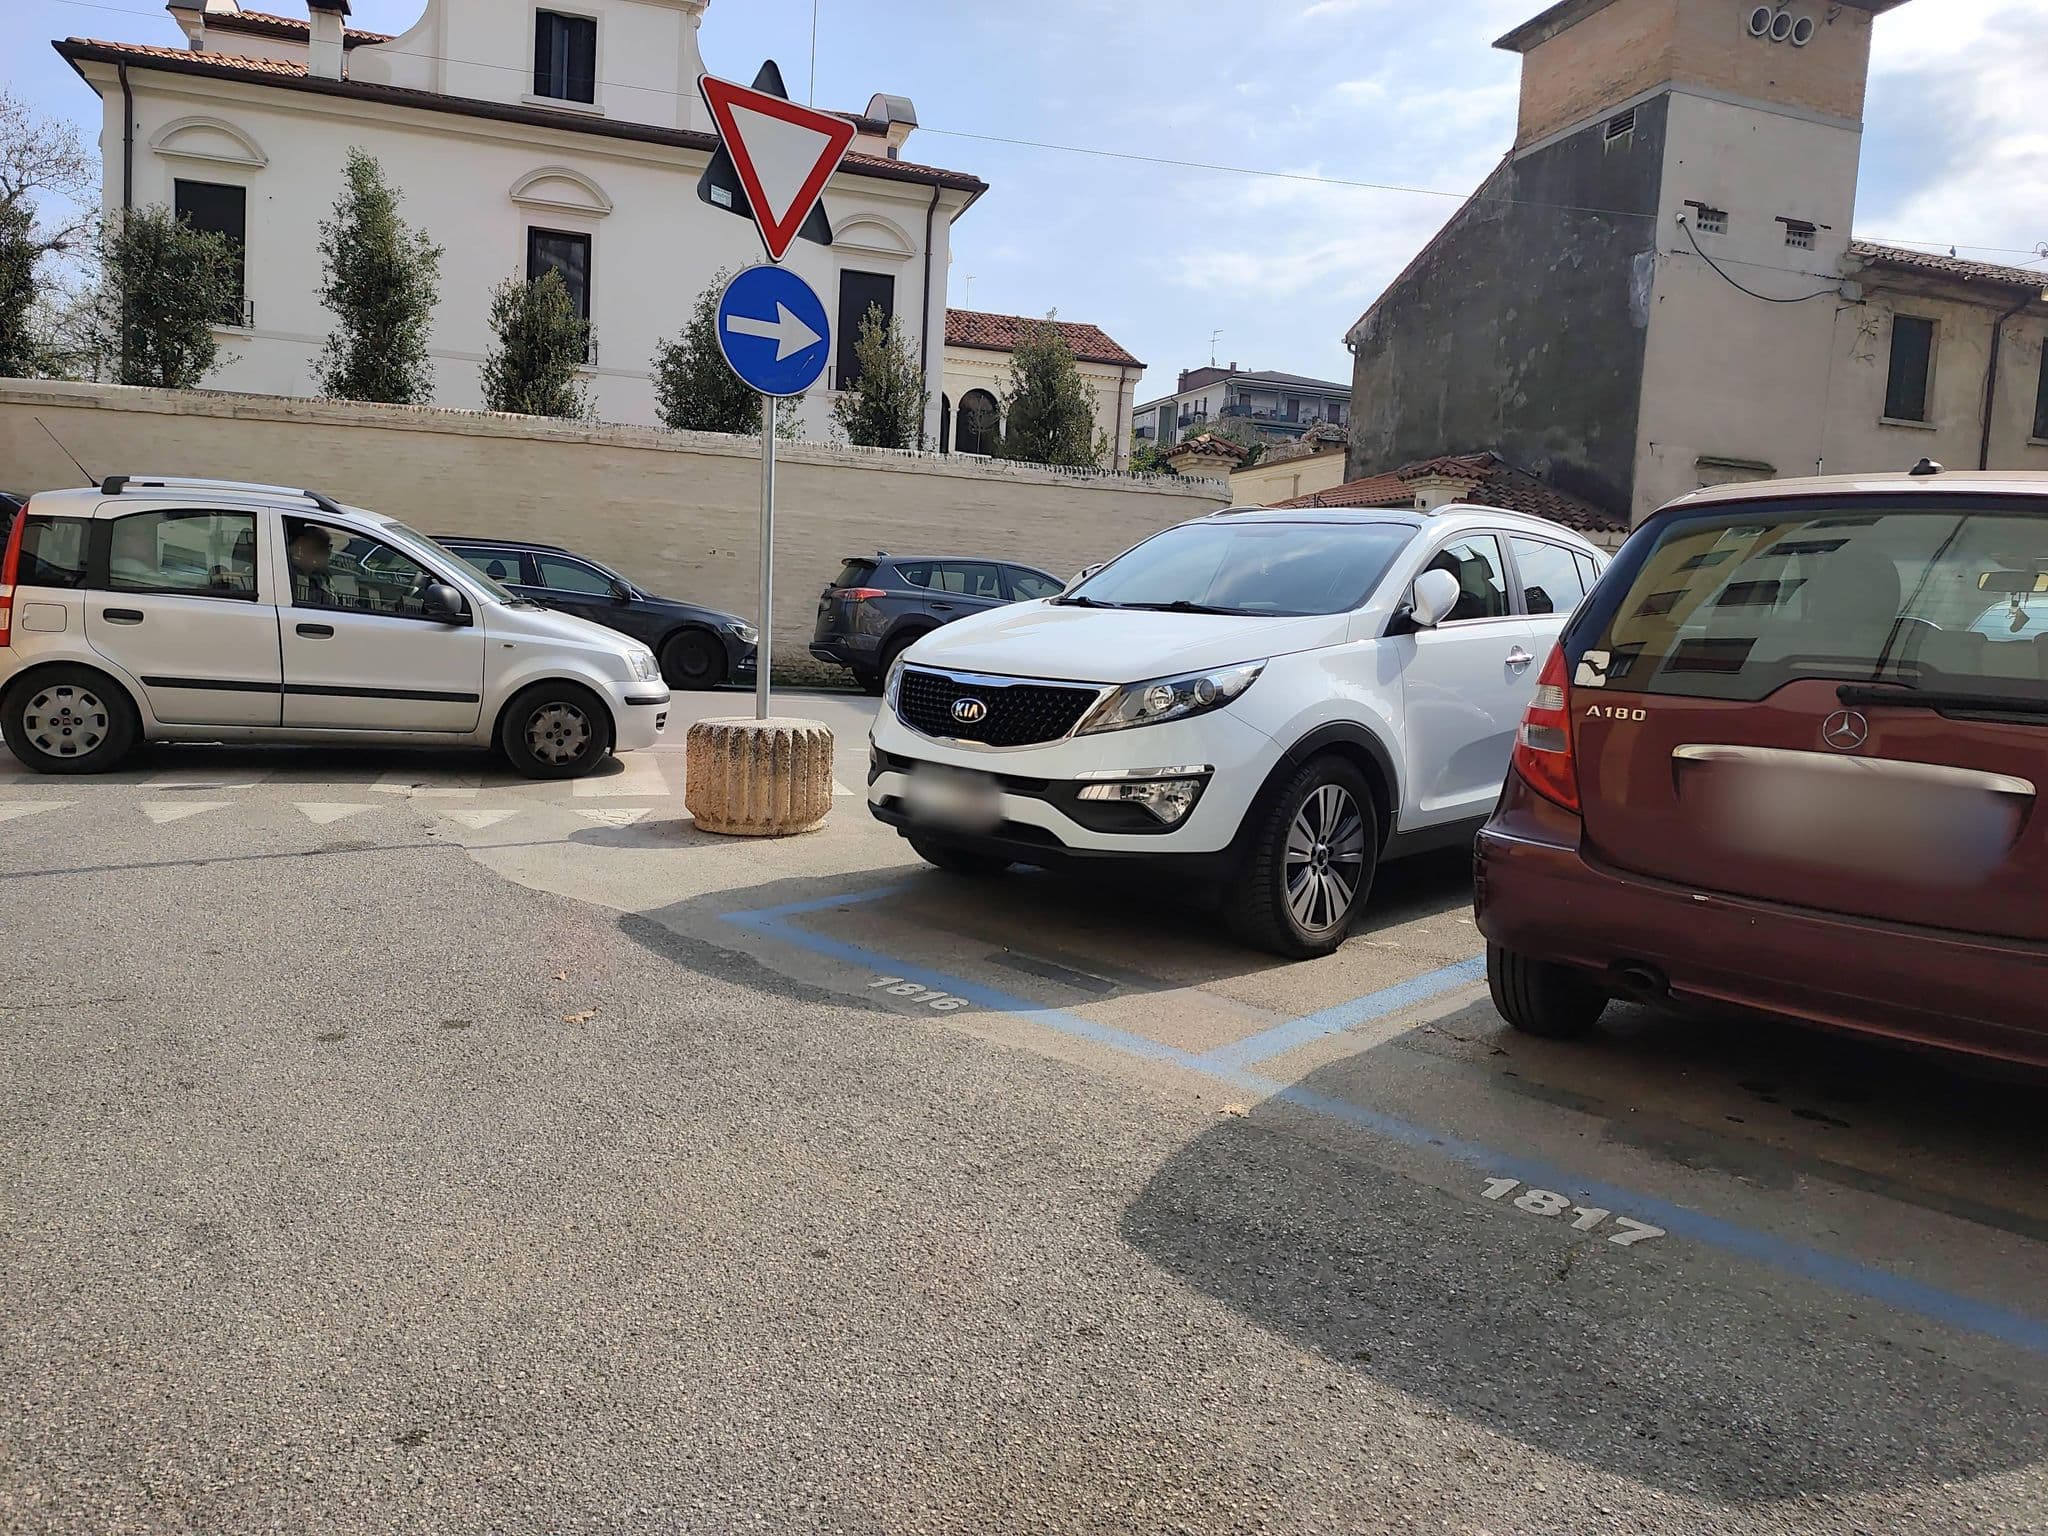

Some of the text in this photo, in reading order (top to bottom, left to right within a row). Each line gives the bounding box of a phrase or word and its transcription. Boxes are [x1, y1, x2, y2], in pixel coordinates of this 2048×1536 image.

[955, 702, 979, 719] KIA
[866, 976, 970, 1010] 1816
[1480, 1176, 1666, 1247] 1817
